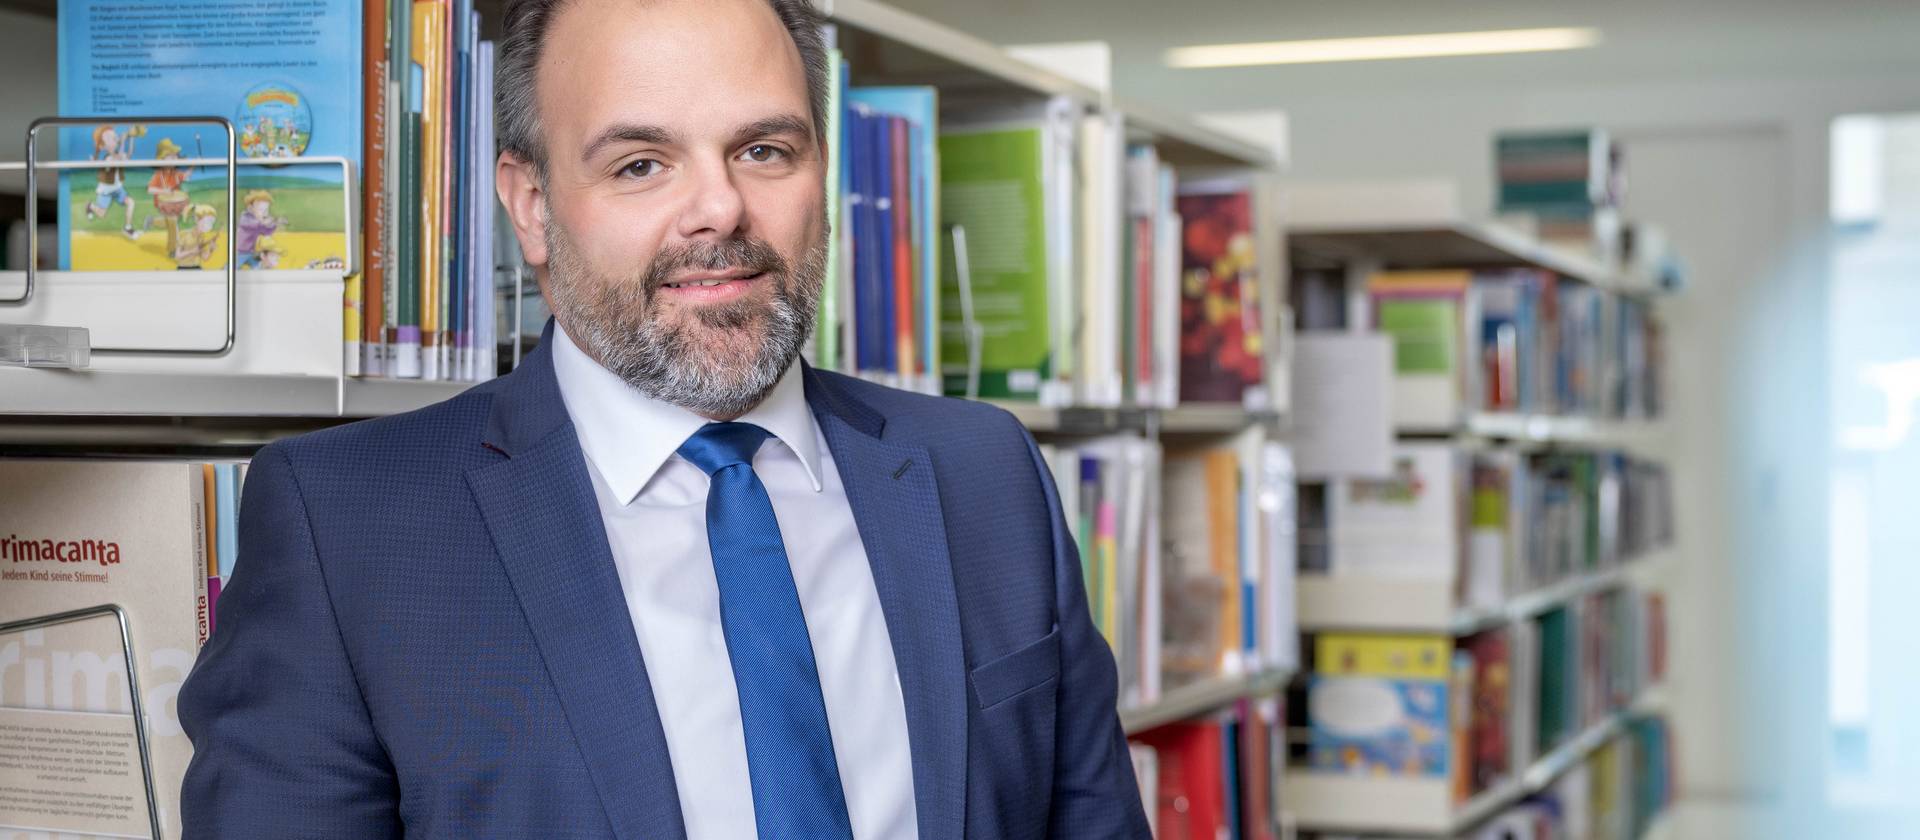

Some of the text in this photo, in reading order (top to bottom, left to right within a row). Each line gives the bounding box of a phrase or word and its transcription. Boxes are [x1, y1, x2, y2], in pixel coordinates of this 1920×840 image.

[0, 534, 121, 566] rimacanta
[2, 569, 109, 584] Jedem Kind seine Stimme!
[197, 596, 207, 645] acanta
